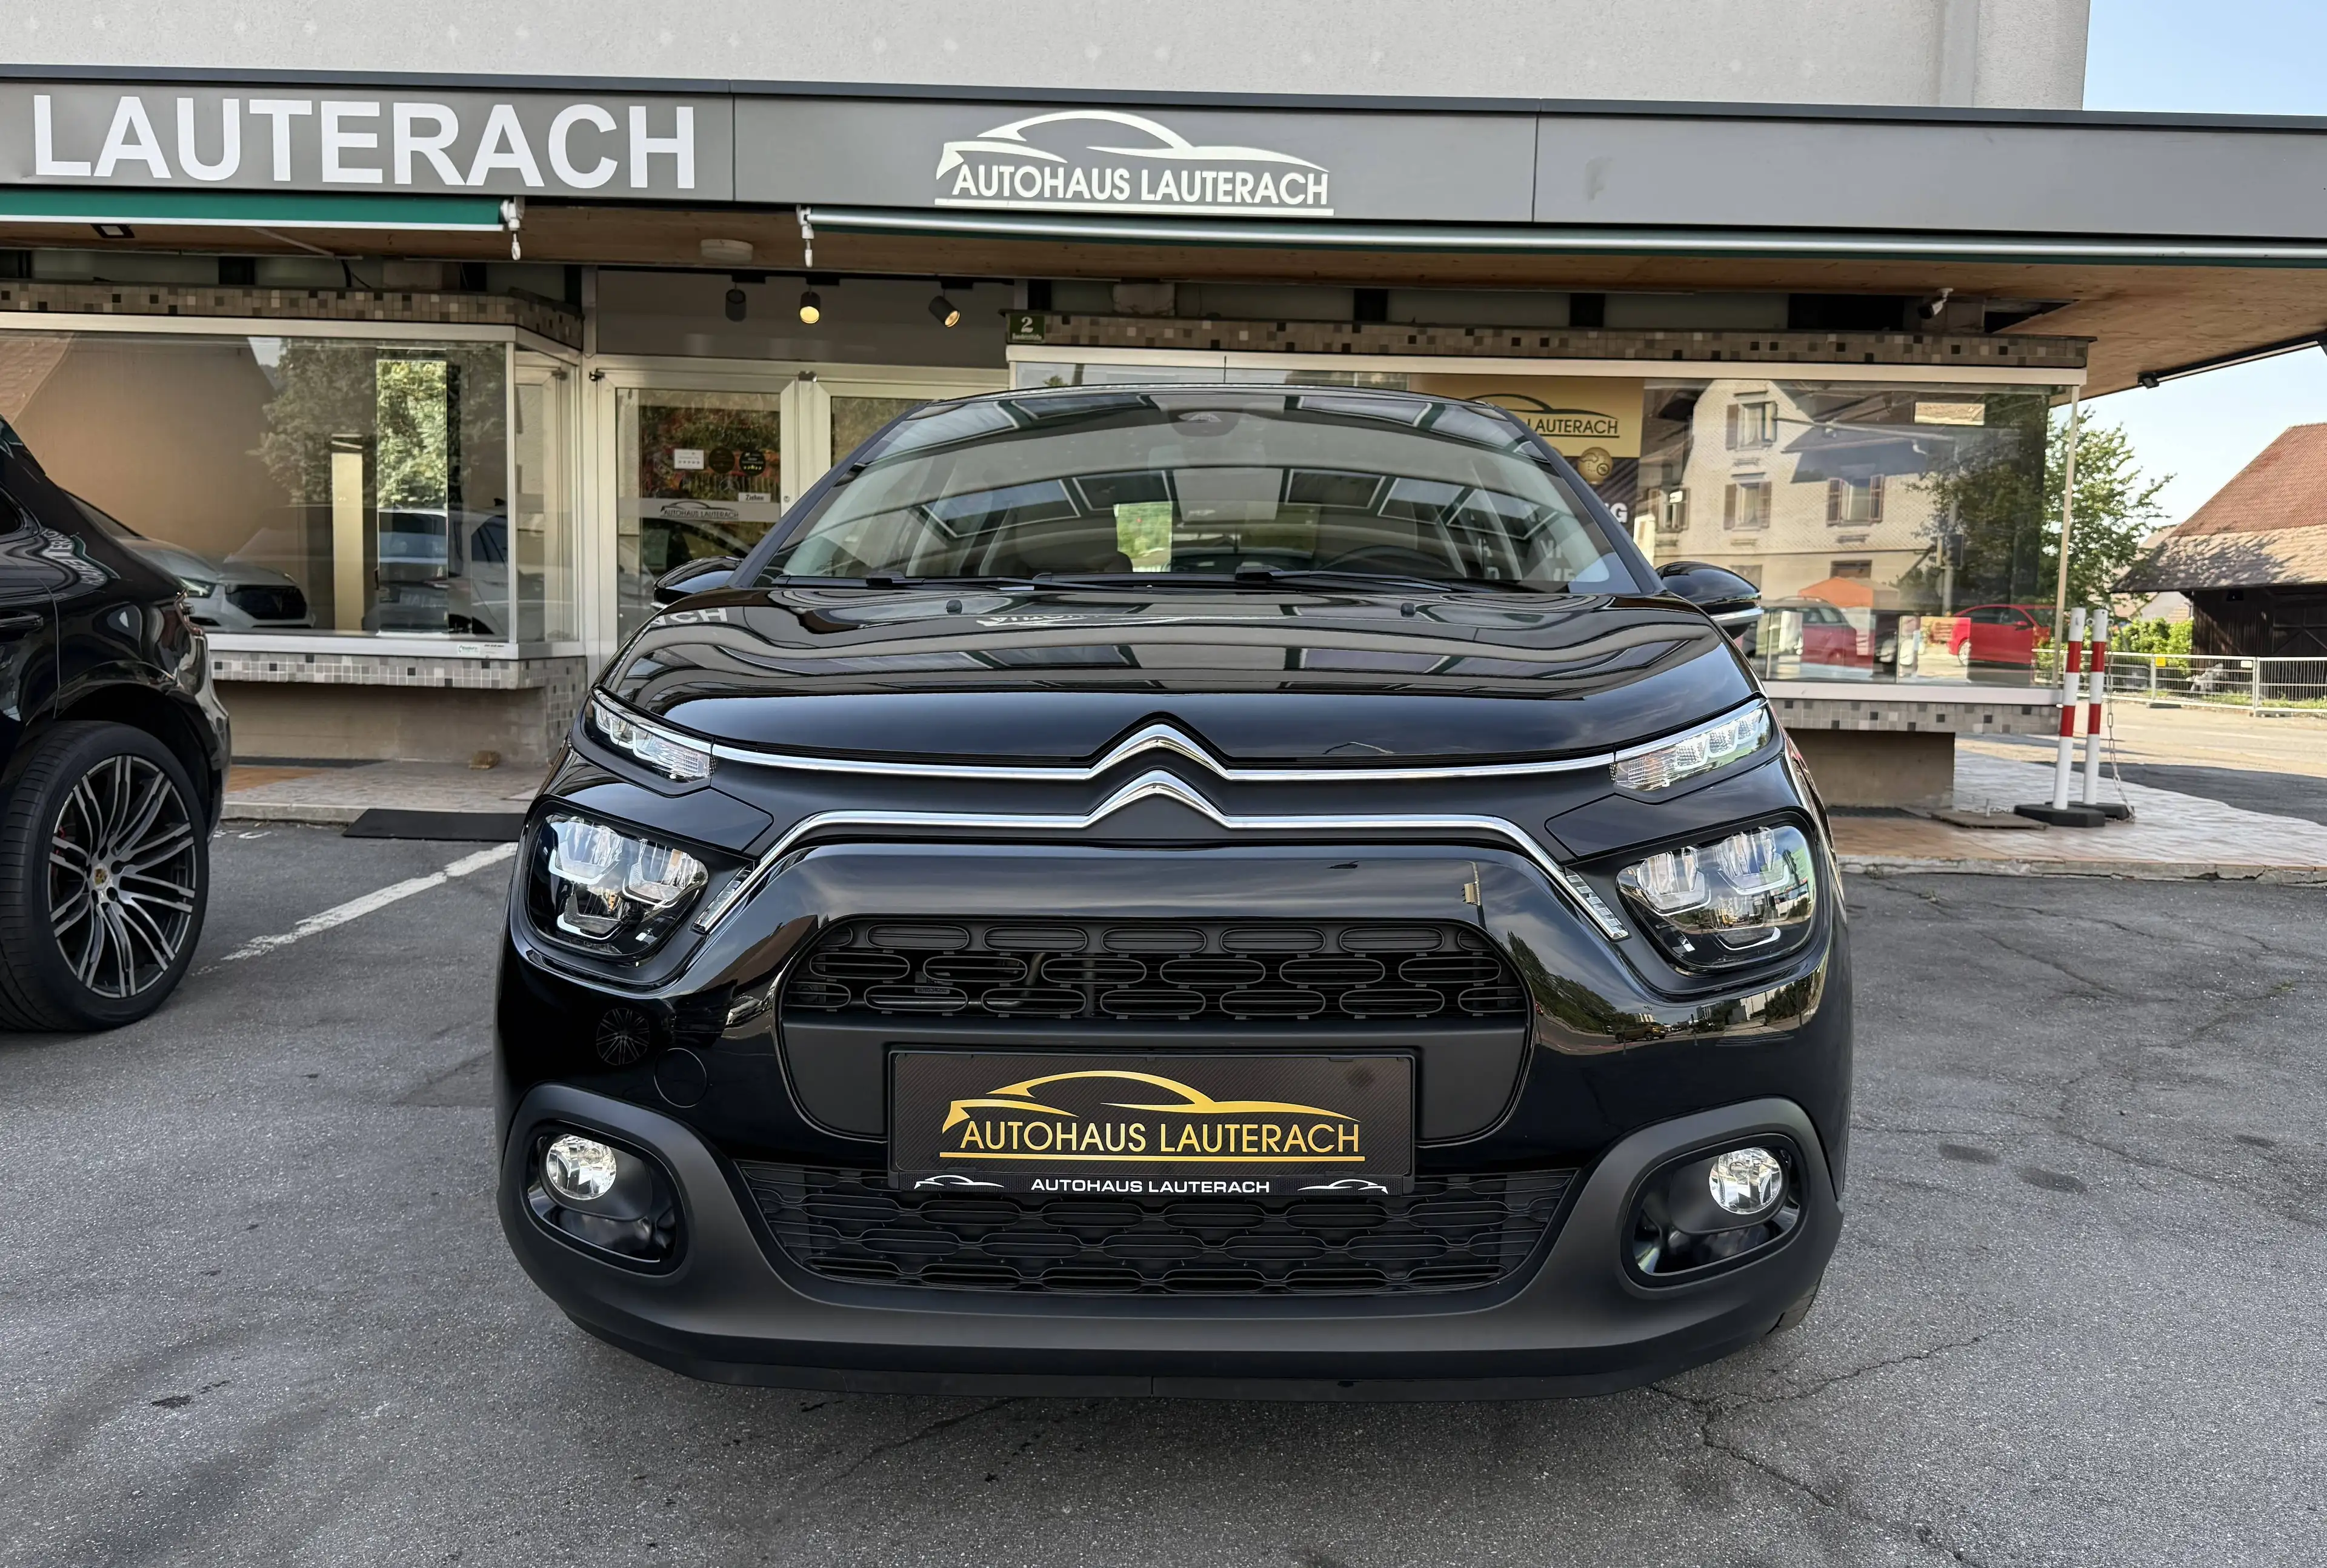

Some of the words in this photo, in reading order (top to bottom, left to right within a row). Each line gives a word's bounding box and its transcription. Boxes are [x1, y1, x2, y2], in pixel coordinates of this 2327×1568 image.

[33, 95, 695, 189] LAUTERACH
[952, 164, 1130, 201] AUTOHAUS
[1141, 169, 1328, 205] LAUTERACH
[1021, 316, 1034, 333] 2
[701, 511, 739, 519] LAUTERACH
[960, 1120, 1147, 1152] AUTOHAUS
[1160, 1123, 1359, 1153] LAUTERACH
[1031, 1178, 1144, 1192] AUTOHAUS
[1148, 1180, 1270, 1194] LAUTERACH
